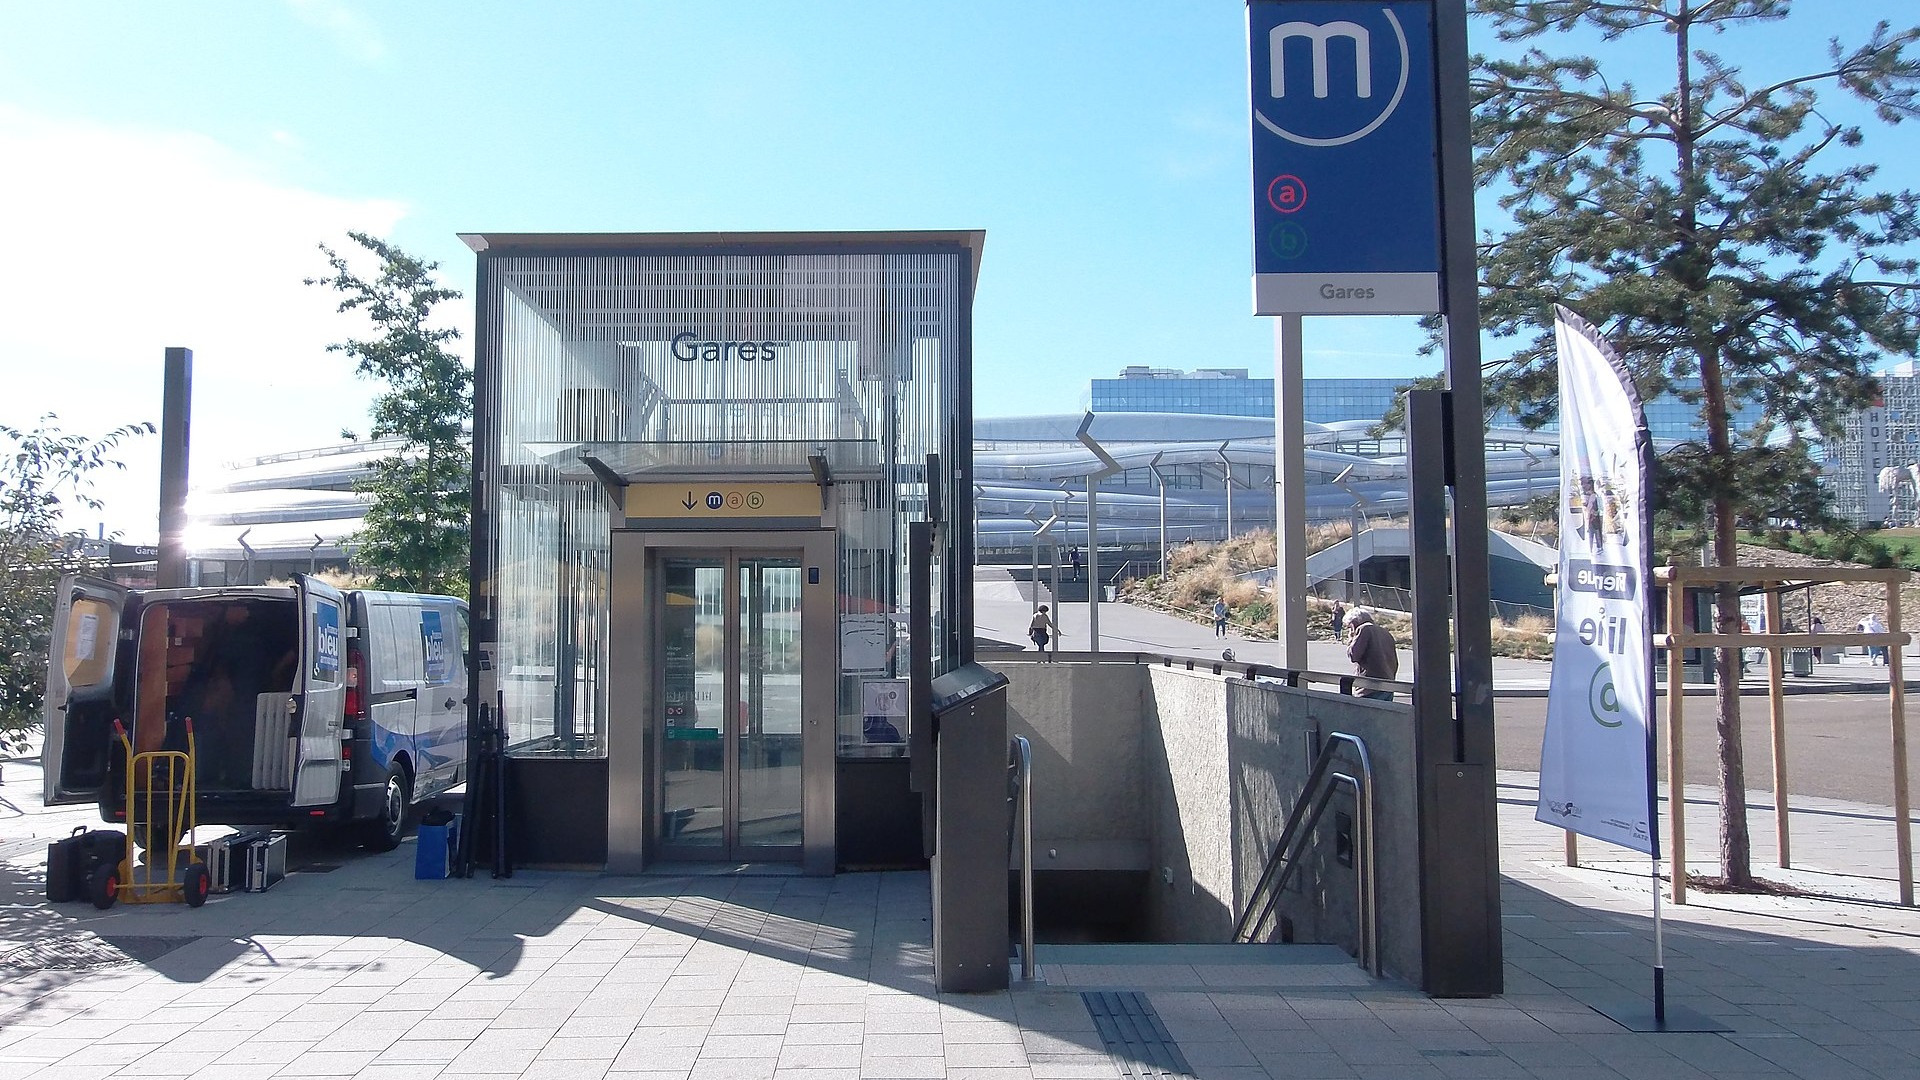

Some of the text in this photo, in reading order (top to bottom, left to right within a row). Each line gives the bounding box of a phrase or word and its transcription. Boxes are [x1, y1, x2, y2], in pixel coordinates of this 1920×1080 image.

[1270, 21, 1371, 98] m
[1280, 185, 1295, 203] a
[1320, 283, 1375, 299] Gares
[671, 331, 776, 362] Gares
[318, 626, 338, 657] bleu
[425, 635, 444, 661] bleu
